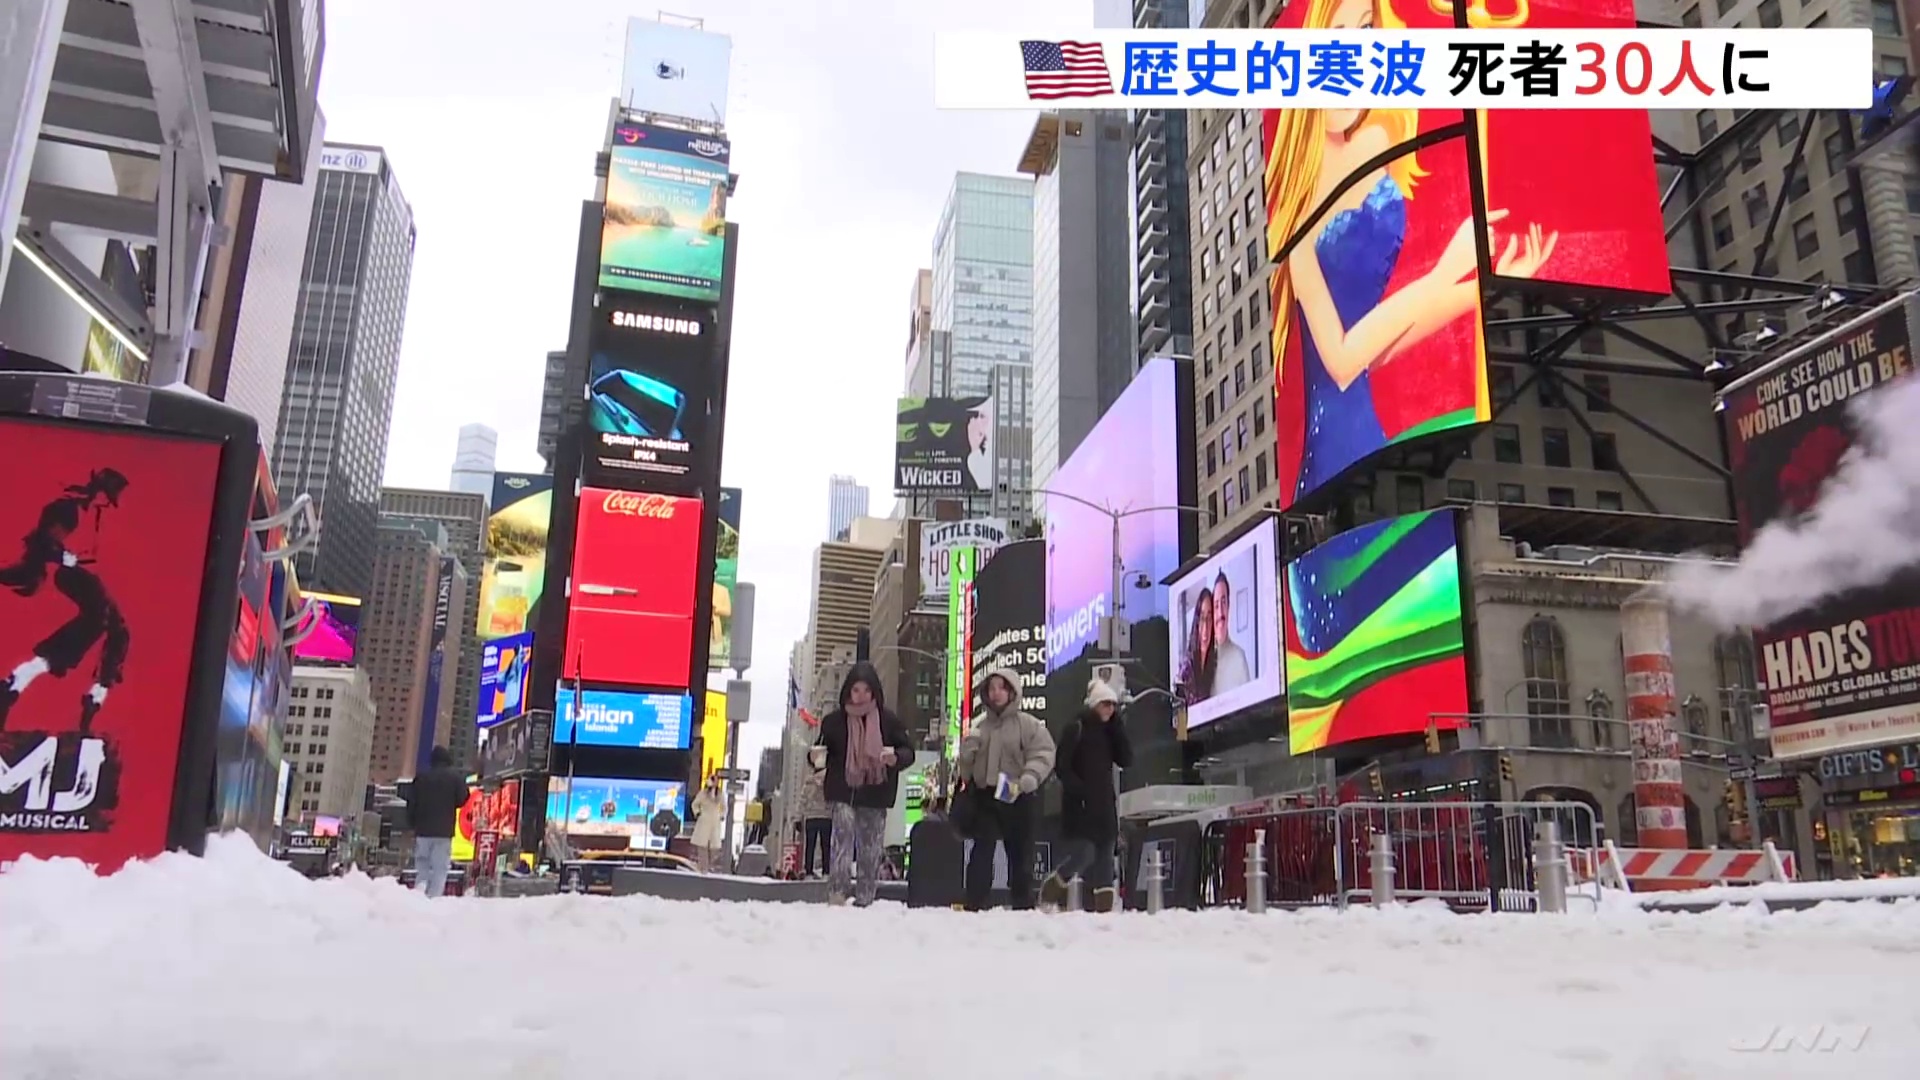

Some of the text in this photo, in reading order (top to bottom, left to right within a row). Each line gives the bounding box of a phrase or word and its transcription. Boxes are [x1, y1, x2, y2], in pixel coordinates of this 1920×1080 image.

[613, 311, 700, 336] SAMSUNG
[1756, 329, 1877, 406] COME SEE HOW THE
[1738, 345, 1911, 442] WORLD COULD BE
[602, 433, 689, 452] Splash-resistant
[603, 490, 678, 519] Coca-Cola
[930, 523, 1004, 546] LITTLE SHOP
[1769, 680, 1840, 705] BROADWAY'S
[1842, 671, 1890, 692] GLOBAL
[565, 703, 634, 725] Ionian
[0, 736, 106, 812] MJ
[1821, 749, 1884, 778] GIFTS
[0, 813, 90, 830] MUSICAL
